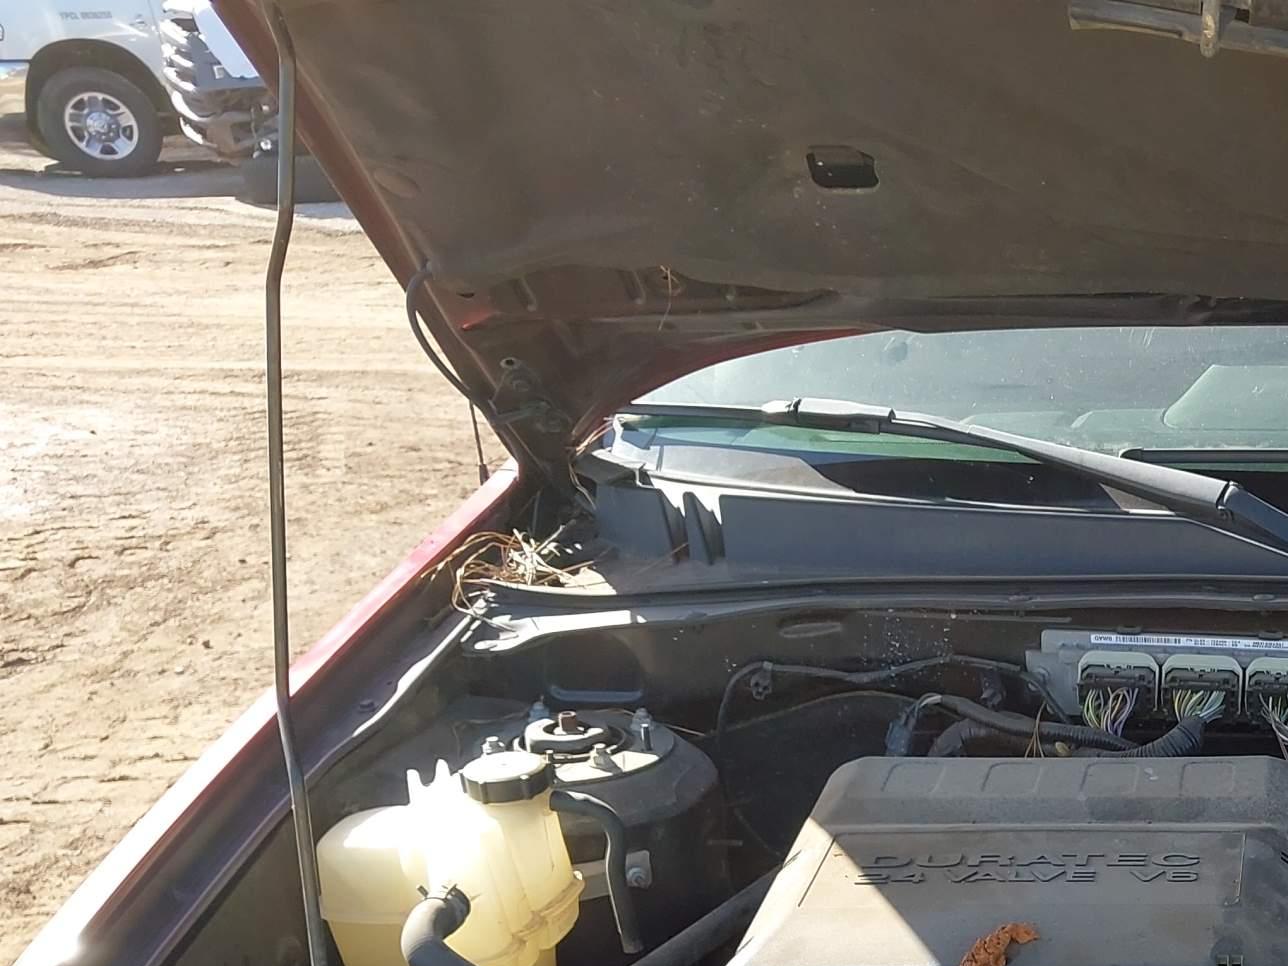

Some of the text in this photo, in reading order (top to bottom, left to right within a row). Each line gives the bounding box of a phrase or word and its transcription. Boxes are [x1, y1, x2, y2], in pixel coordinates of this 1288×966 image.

[860, 852, 1201, 869] DURATEC
[946, 869, 1097, 883] VALVE
[1129, 870, 1200, 883] V6
